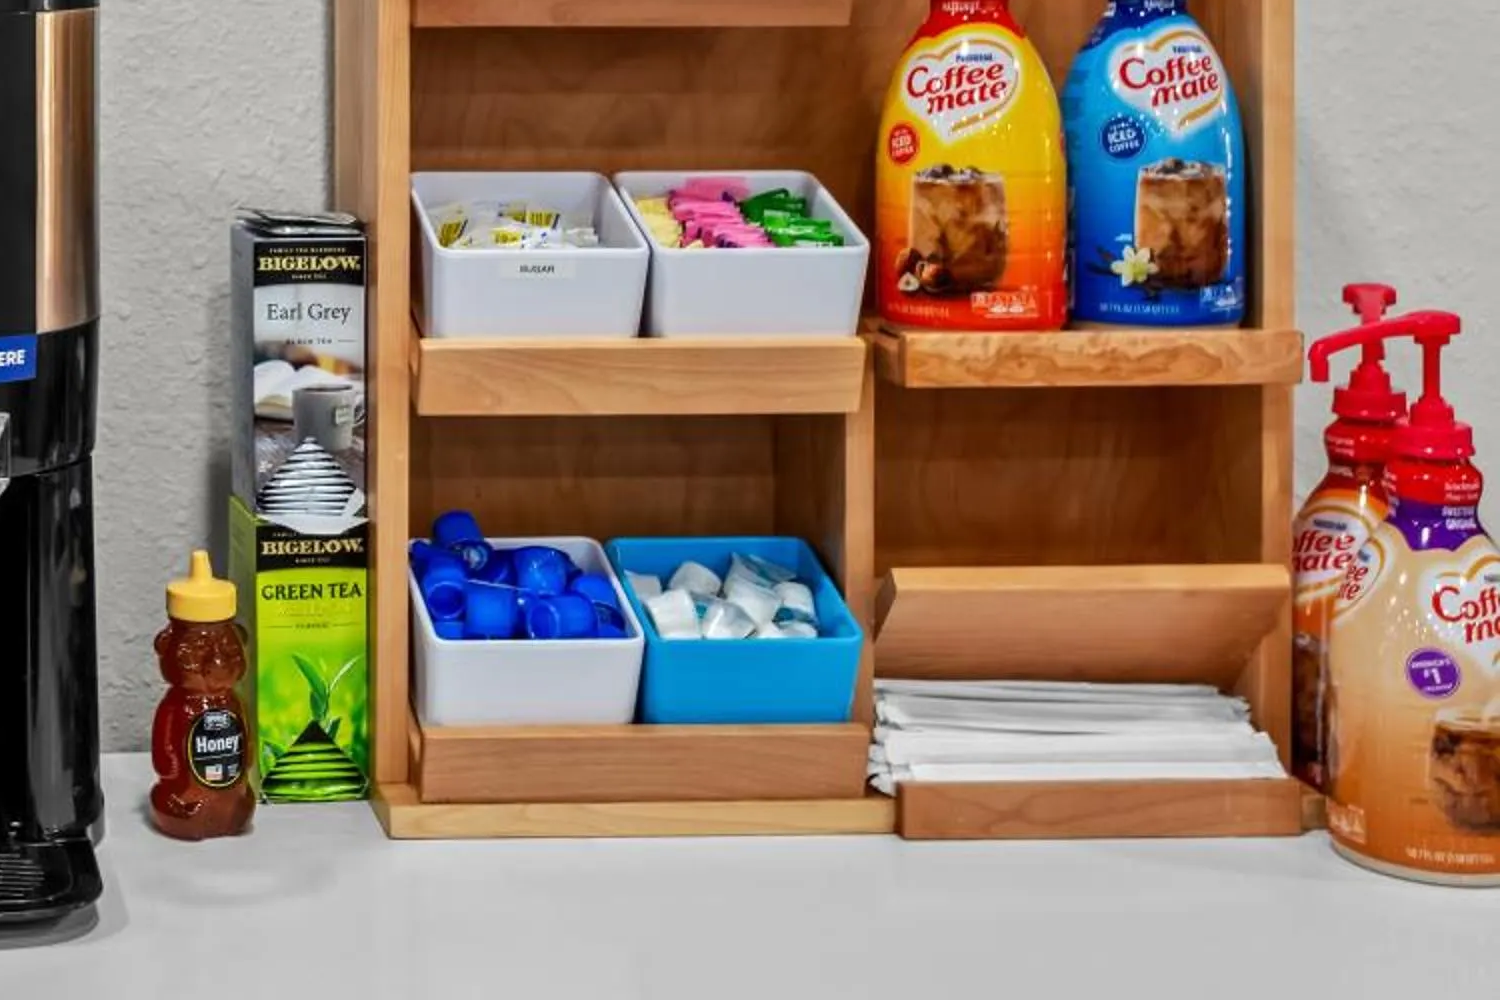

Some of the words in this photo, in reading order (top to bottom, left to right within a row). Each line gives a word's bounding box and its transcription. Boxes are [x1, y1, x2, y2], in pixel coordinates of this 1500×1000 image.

[907, 63, 1005, 99] Coffee
[1119, 55, 1213, 90] Coffee
[927, 80, 1007, 115] mate
[1151, 72, 1219, 108] mate
[258, 255, 360, 272] BIGELOW
[267, 302, 303, 321] Earl
[308, 303, 352, 326] Grey
[261, 538, 362, 555] BIGELOW
[261, 583, 323, 601] GREEN
[328, 582, 362, 599] TEA
[1431, 586, 1500, 622] Coff
[195, 735, 240, 754] Honey
